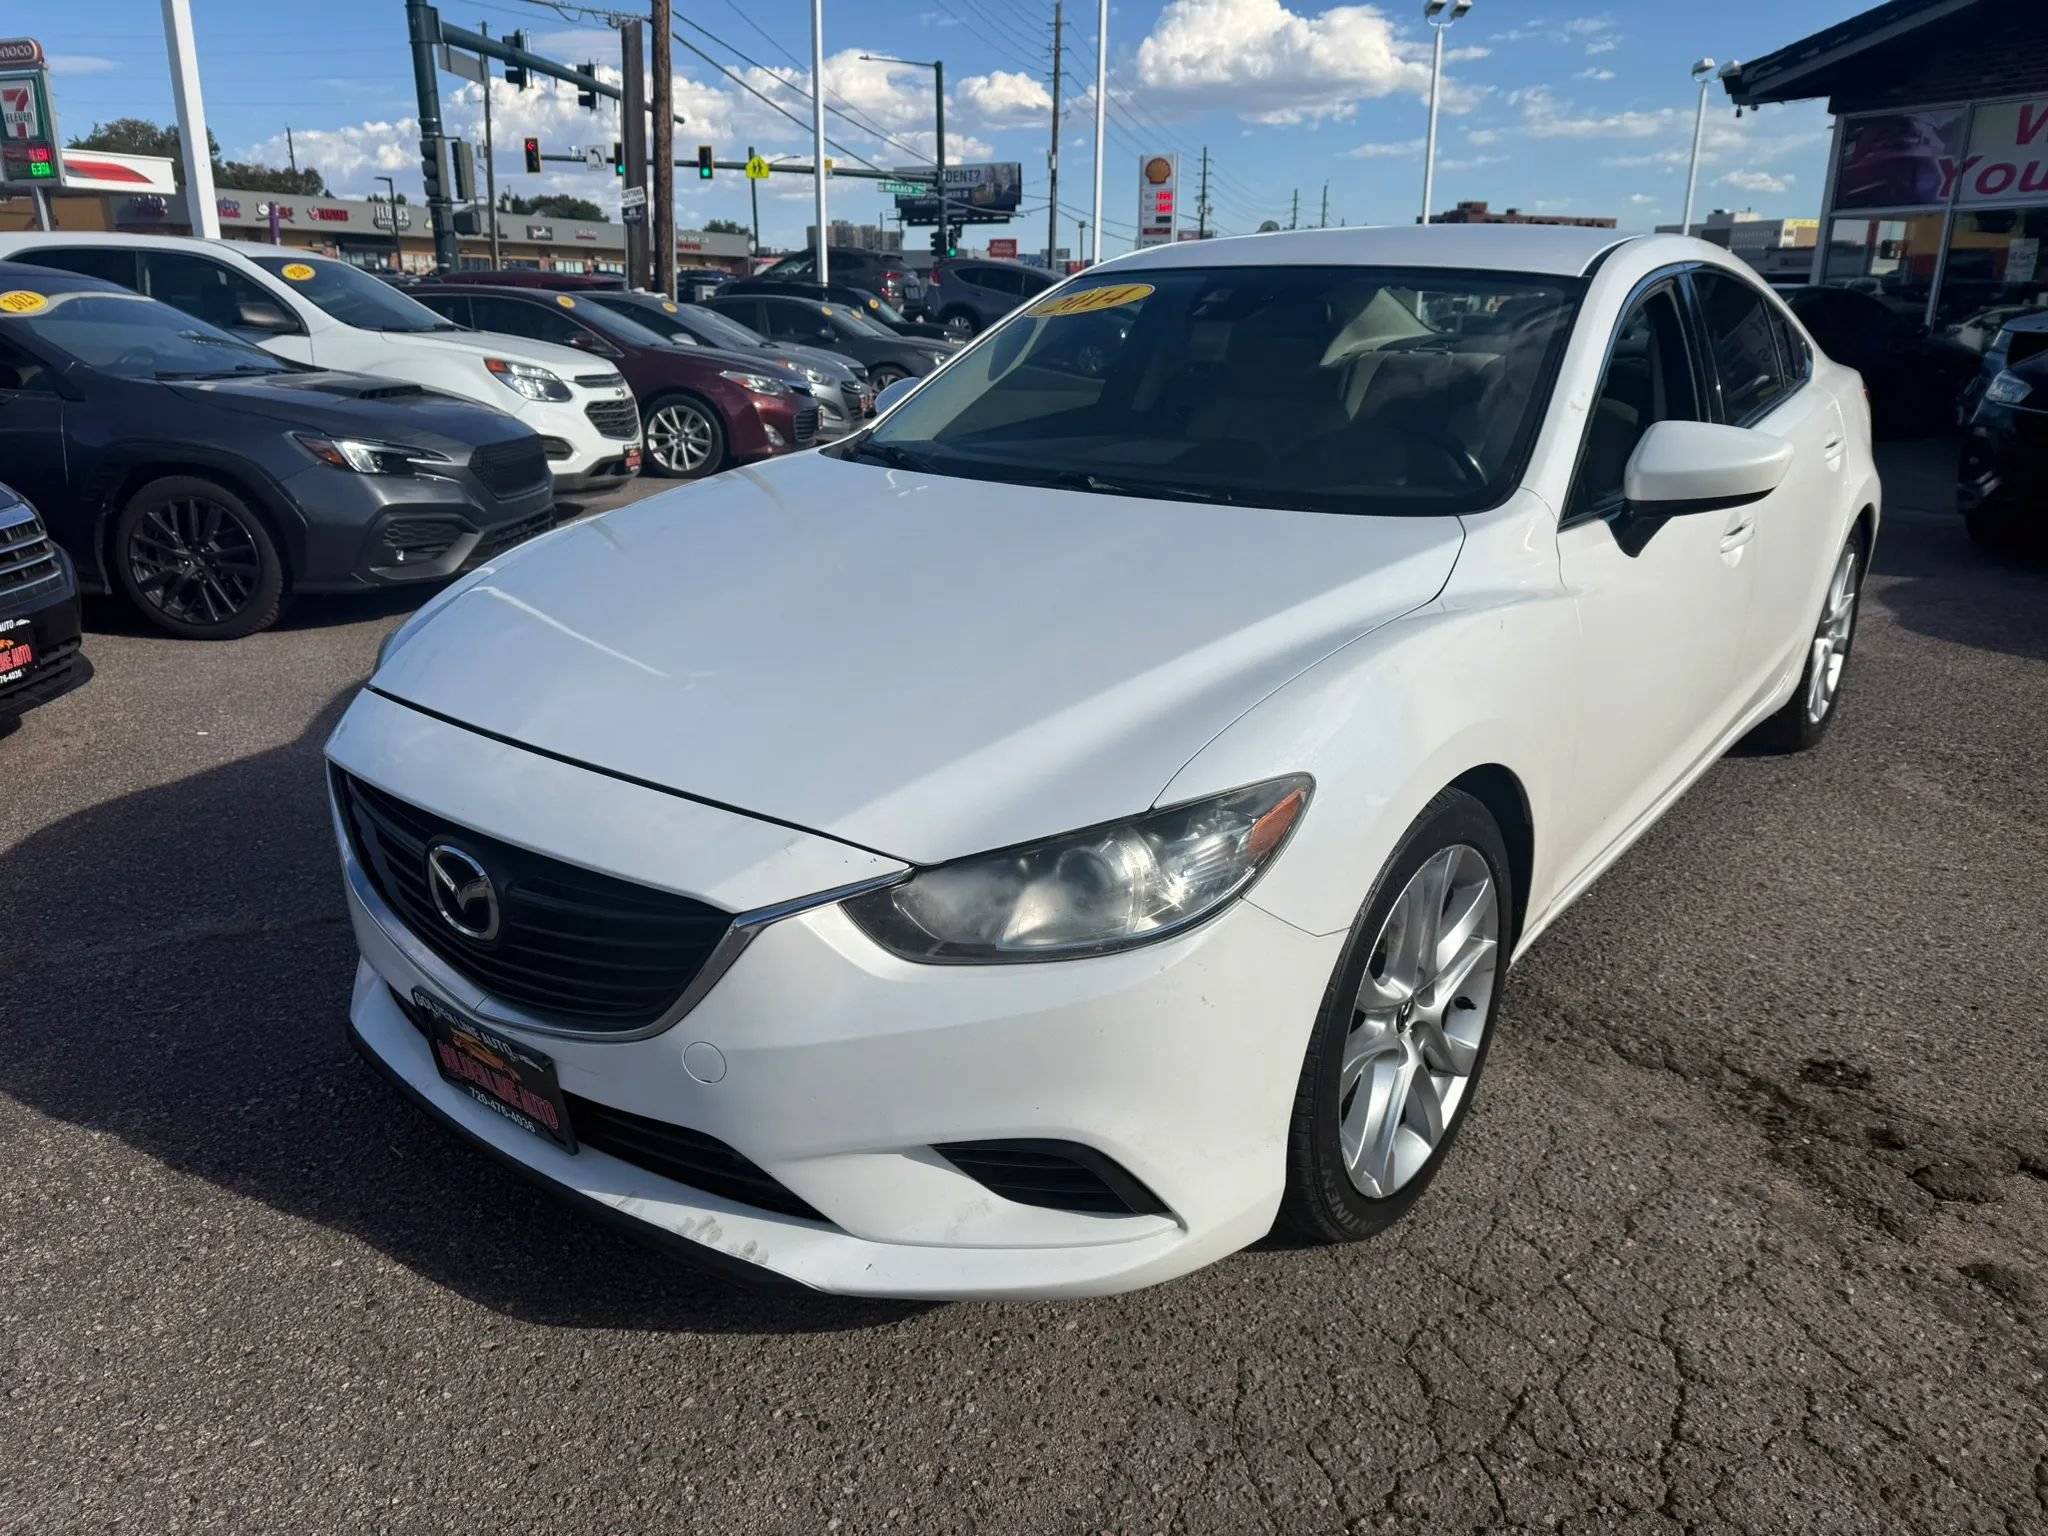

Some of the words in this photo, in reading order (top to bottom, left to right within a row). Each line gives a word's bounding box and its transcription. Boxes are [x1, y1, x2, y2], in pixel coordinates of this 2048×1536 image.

[0, 45, 32, 58] noco
[885, 183, 913, 193] Monaco
[1041, 286, 1140, 314] 2014
[11, 644, 32, 667] AUTO
[456, 1016, 482, 1042] LINE
[480, 1032, 514, 1057] AUTO
[519, 1084, 559, 1130] AUTO
